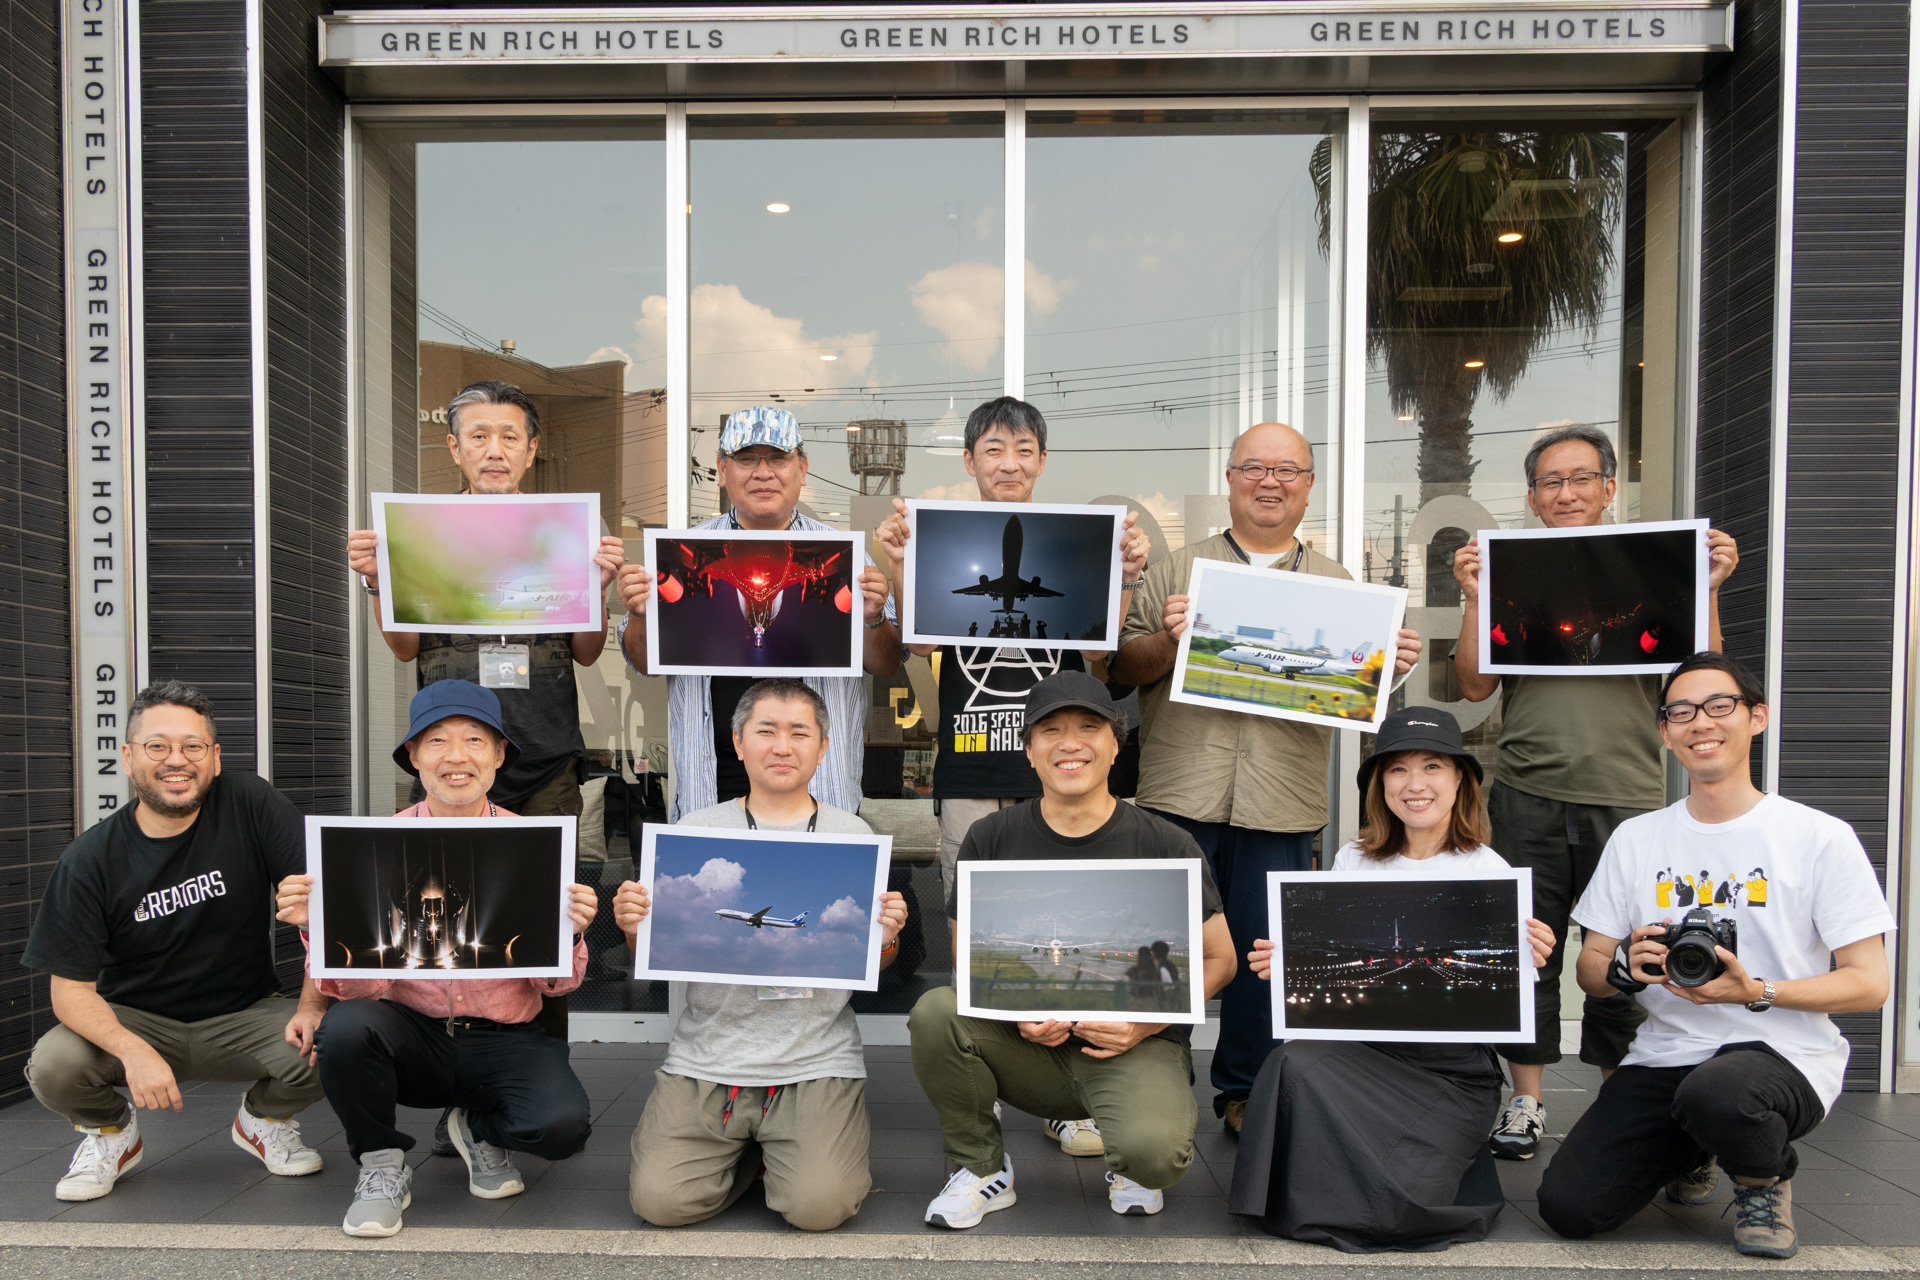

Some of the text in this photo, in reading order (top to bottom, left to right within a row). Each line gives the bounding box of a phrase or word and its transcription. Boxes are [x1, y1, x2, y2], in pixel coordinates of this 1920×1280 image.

[382, 29, 723, 51] GREEN RICH HOTELS
[841, 24, 1189, 48] GREEN RICH HOTELS
[1311, 18, 1665, 42] GREEN RICH HOTELS
[84, 56, 107, 195] HOTELS
[87, 248, 114, 617] GREEN RICH HOTELS
[1254, 651, 1287, 663] J-AIR
[953, 712, 988, 735] 2016
[96, 663, 118, 823] GREEN R
[134, 870, 227, 922] CREATORS
